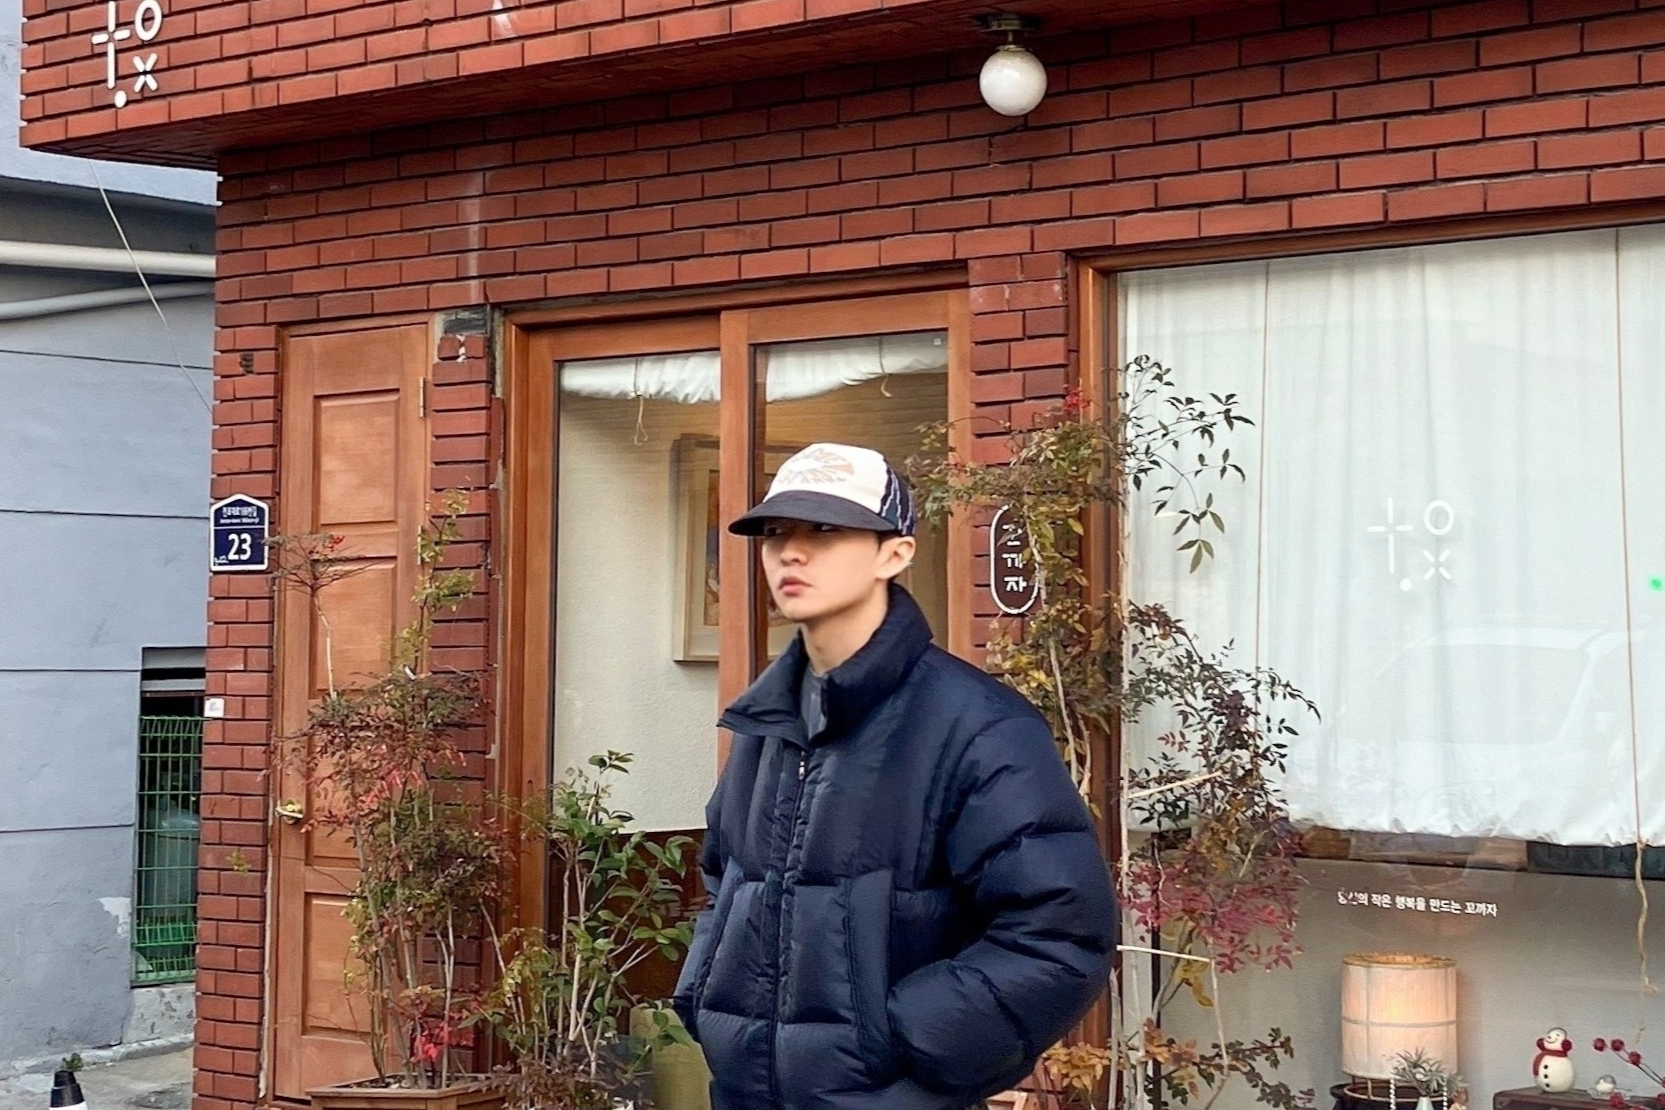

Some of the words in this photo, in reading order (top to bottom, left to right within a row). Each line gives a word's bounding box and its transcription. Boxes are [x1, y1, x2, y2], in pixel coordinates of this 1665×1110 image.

[227, 533, 252, 560] 23
[1371, 893, 1393, 908] 작은
[1394, 894, 1426, 911] 행복을
[1429, 898, 1462, 914] 만드는
[1464, 901, 1498, 917] 꼬까자
